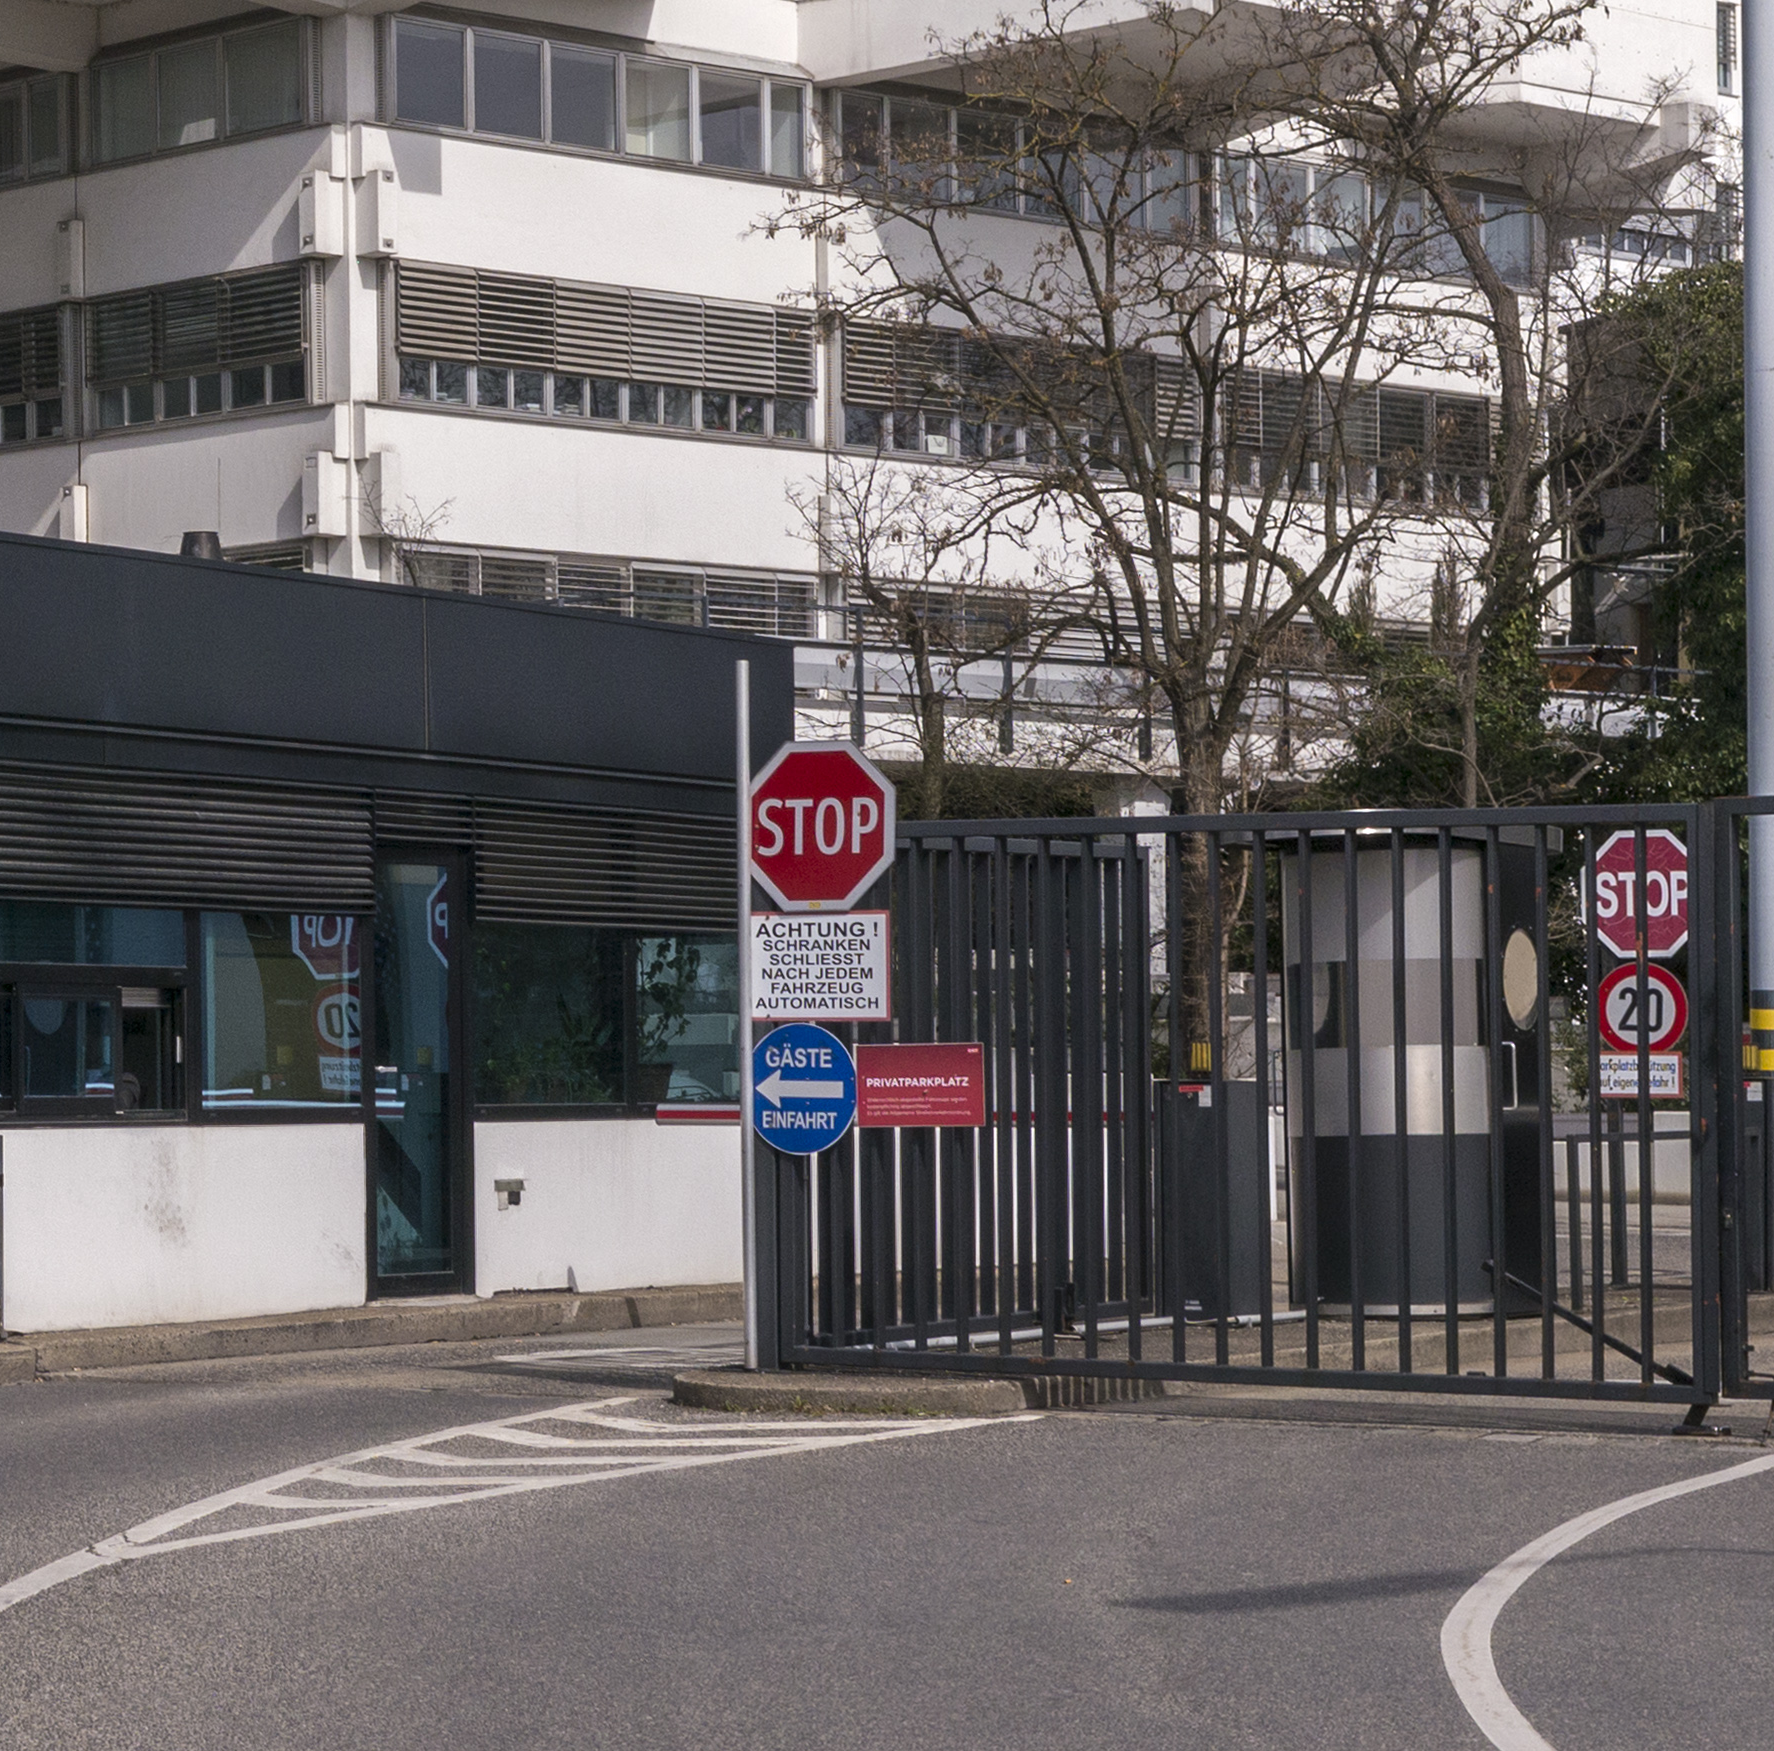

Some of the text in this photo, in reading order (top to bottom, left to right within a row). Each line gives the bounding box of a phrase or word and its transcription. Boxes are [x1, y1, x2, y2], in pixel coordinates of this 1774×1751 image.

[757, 797, 879, 856] STOP
[1597, 870, 1688, 918] STOP
[756, 922, 865, 938] ACHTUNG
[762, 939, 870, 951] SCHRANKEN
[769, 953, 864, 966] SCHLIESST
[761, 967, 873, 979] NACH JEDEM
[771, 982, 864, 994] FAHRZEUG
[755, 997, 879, 1009] AUTOMATISCH
[1618, 987, 1663, 1033] 20
[765, 1043, 832, 1068] GÄSTE
[866, 1076, 969, 1088] PRIVATPARKPLATZ
[762, 1111, 838, 1129] EINFAHRT
